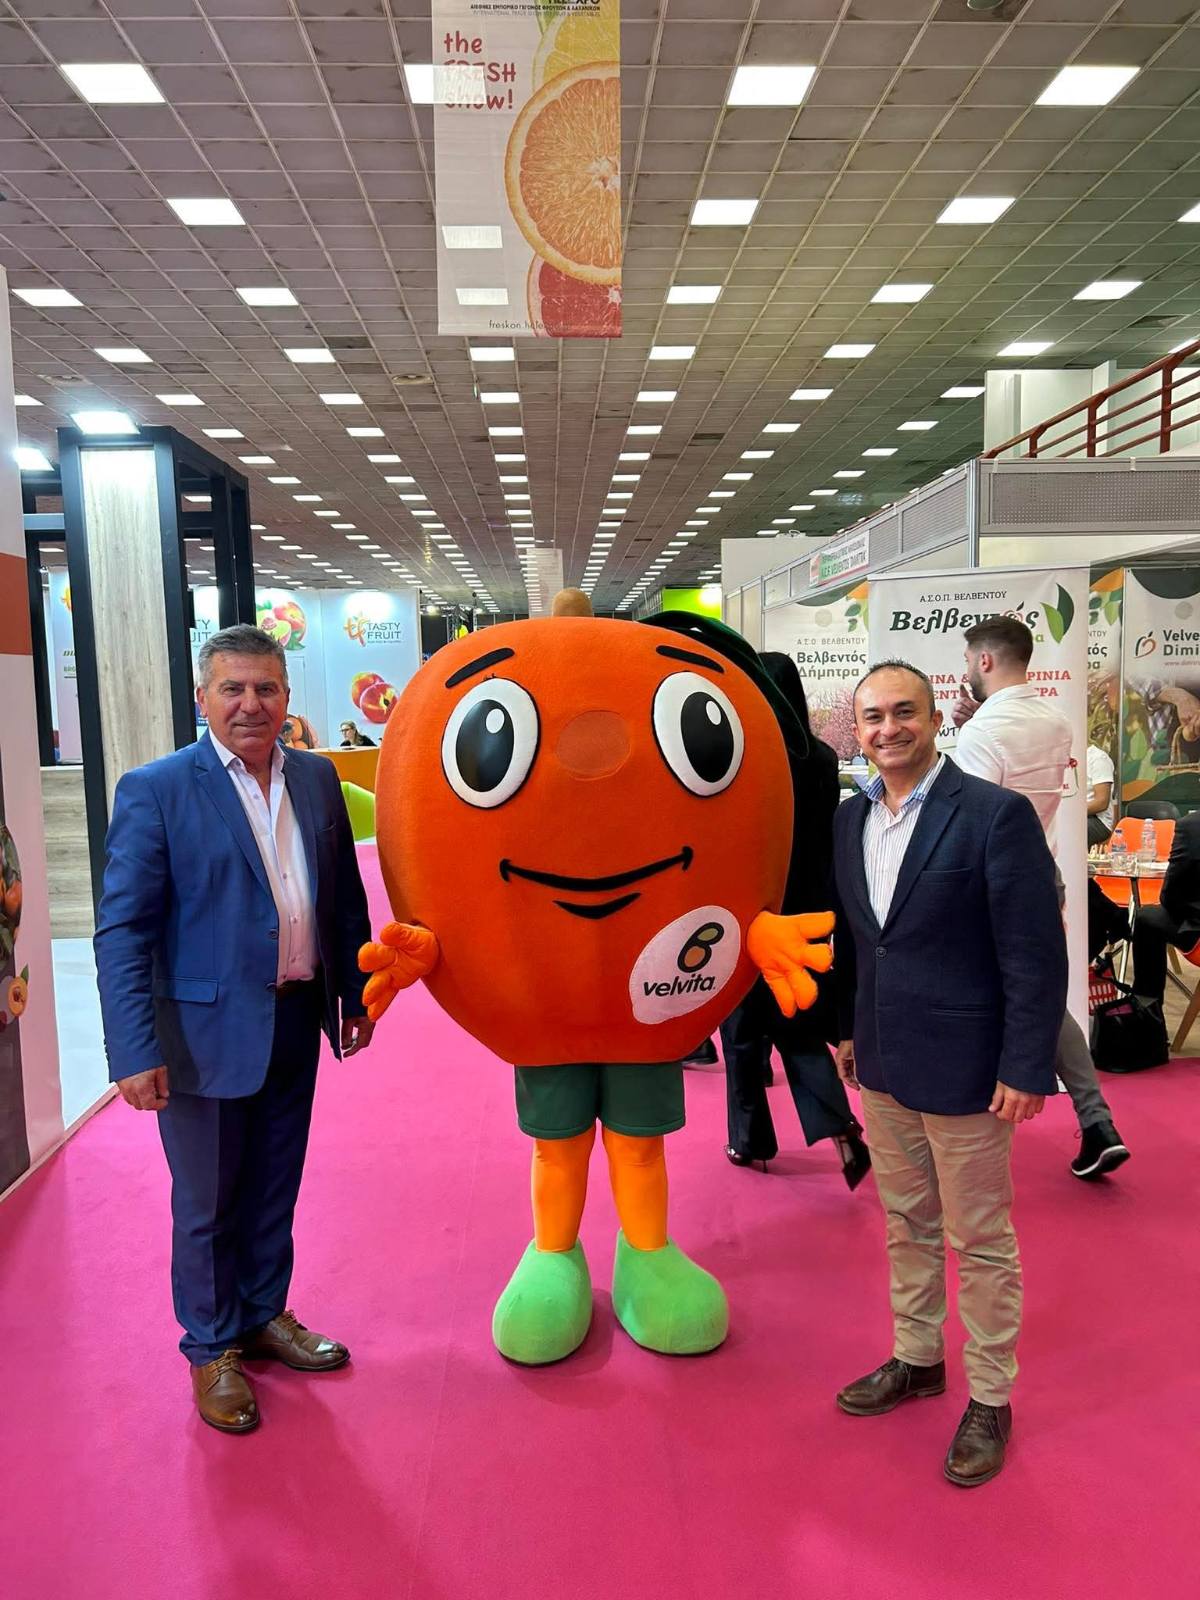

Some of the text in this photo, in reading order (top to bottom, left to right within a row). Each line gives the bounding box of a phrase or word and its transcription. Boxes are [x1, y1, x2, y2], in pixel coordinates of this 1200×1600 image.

[444, 31, 482, 54] the
[954, 591, 1007, 600] ΒΕΛΒΕΝΤΟΥ
[367, 623, 401, 631] TASTY
[367, 631, 402, 640] FRUIT
[1163, 629, 1200, 641] Velve
[1163, 644, 1200, 656] Dimi
[797, 650, 867, 665] Βελβεντός
[799, 665, 859, 680] Δήμητρα
[961, 673, 969, 683] &
